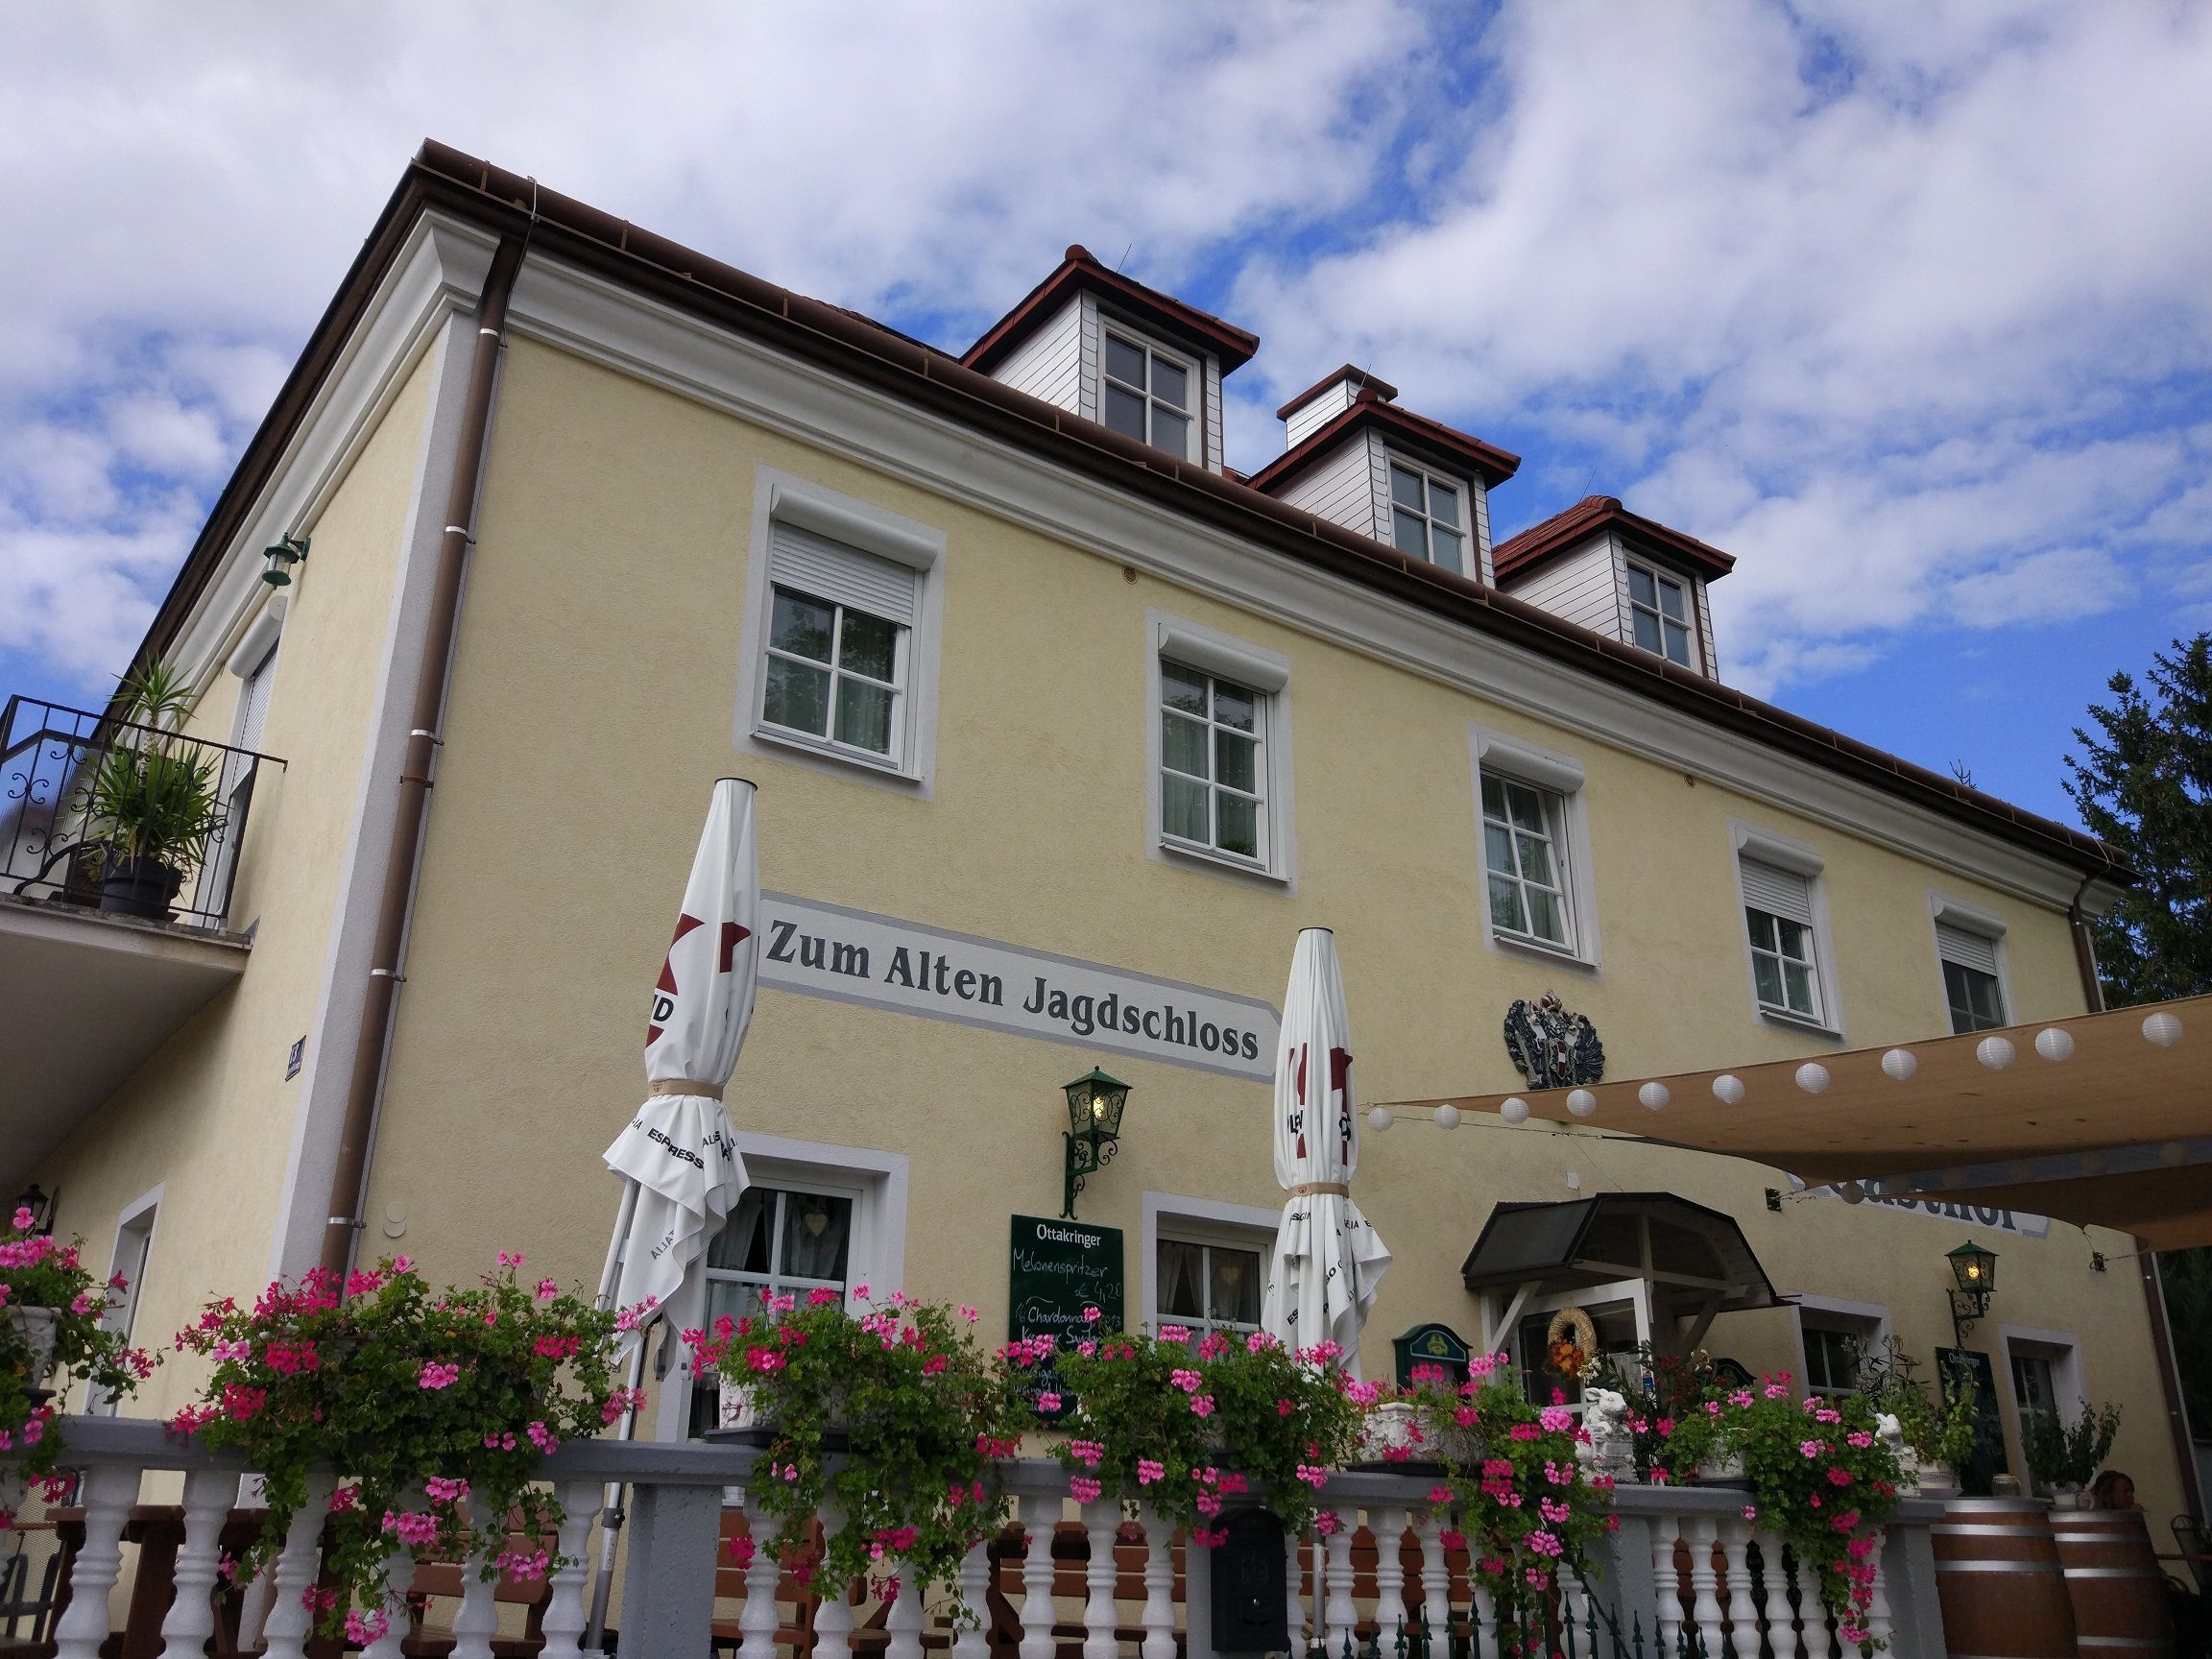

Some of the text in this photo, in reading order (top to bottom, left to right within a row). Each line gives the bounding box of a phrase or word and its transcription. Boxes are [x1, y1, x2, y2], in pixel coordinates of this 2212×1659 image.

[766, 919, 1260, 1061] Zum Alten Jagdschloss
[1036, 1223, 1102, 1249] Ottakringer
[1013, 1247, 1108, 1285] Melonenspritzer
